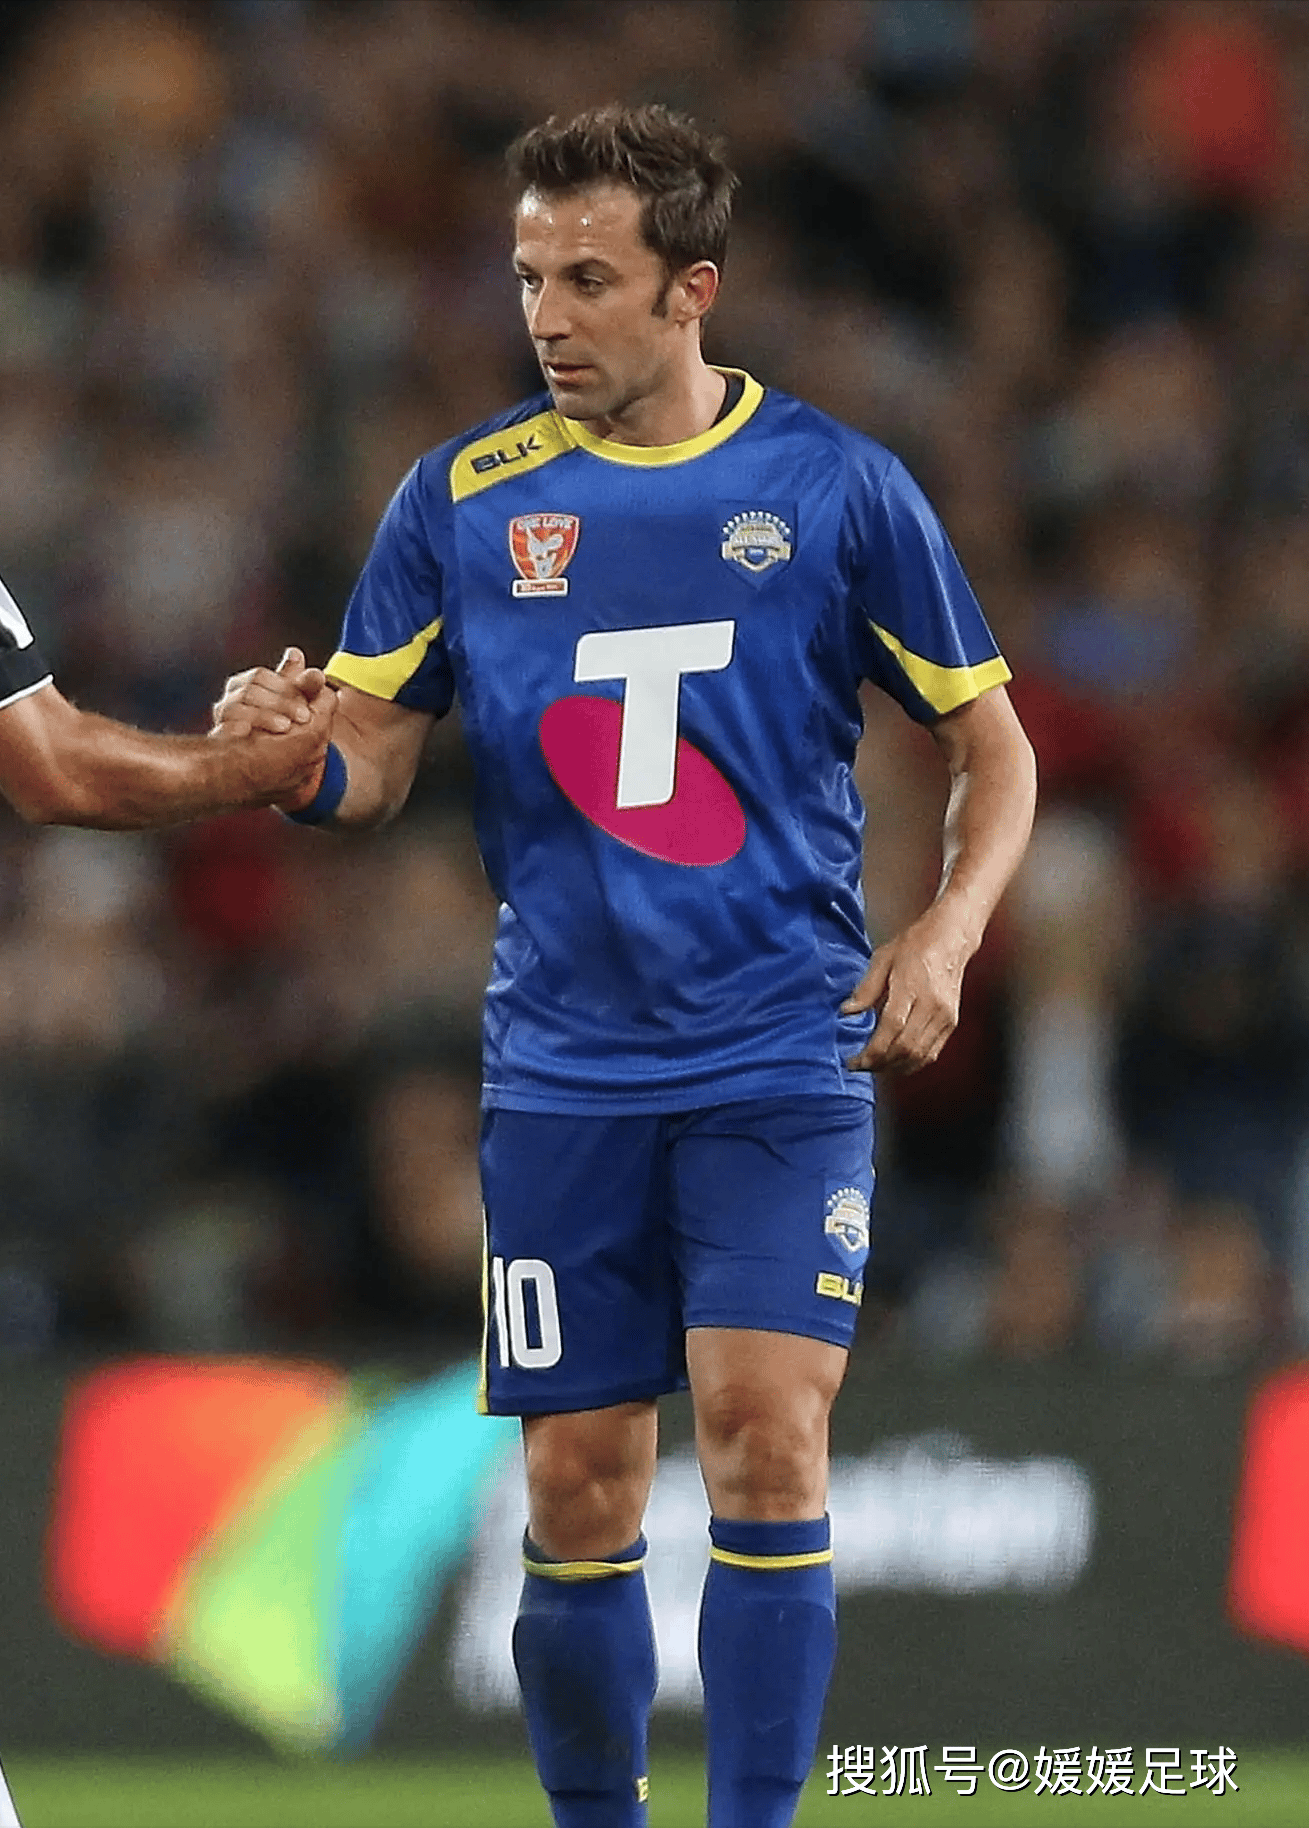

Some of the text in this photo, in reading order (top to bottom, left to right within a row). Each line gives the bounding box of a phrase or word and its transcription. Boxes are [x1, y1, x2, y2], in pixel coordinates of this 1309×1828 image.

[470, 434, 542, 474] BLK
[574, 619, 736, 810] T
[492, 1256, 562, 1369] 10
